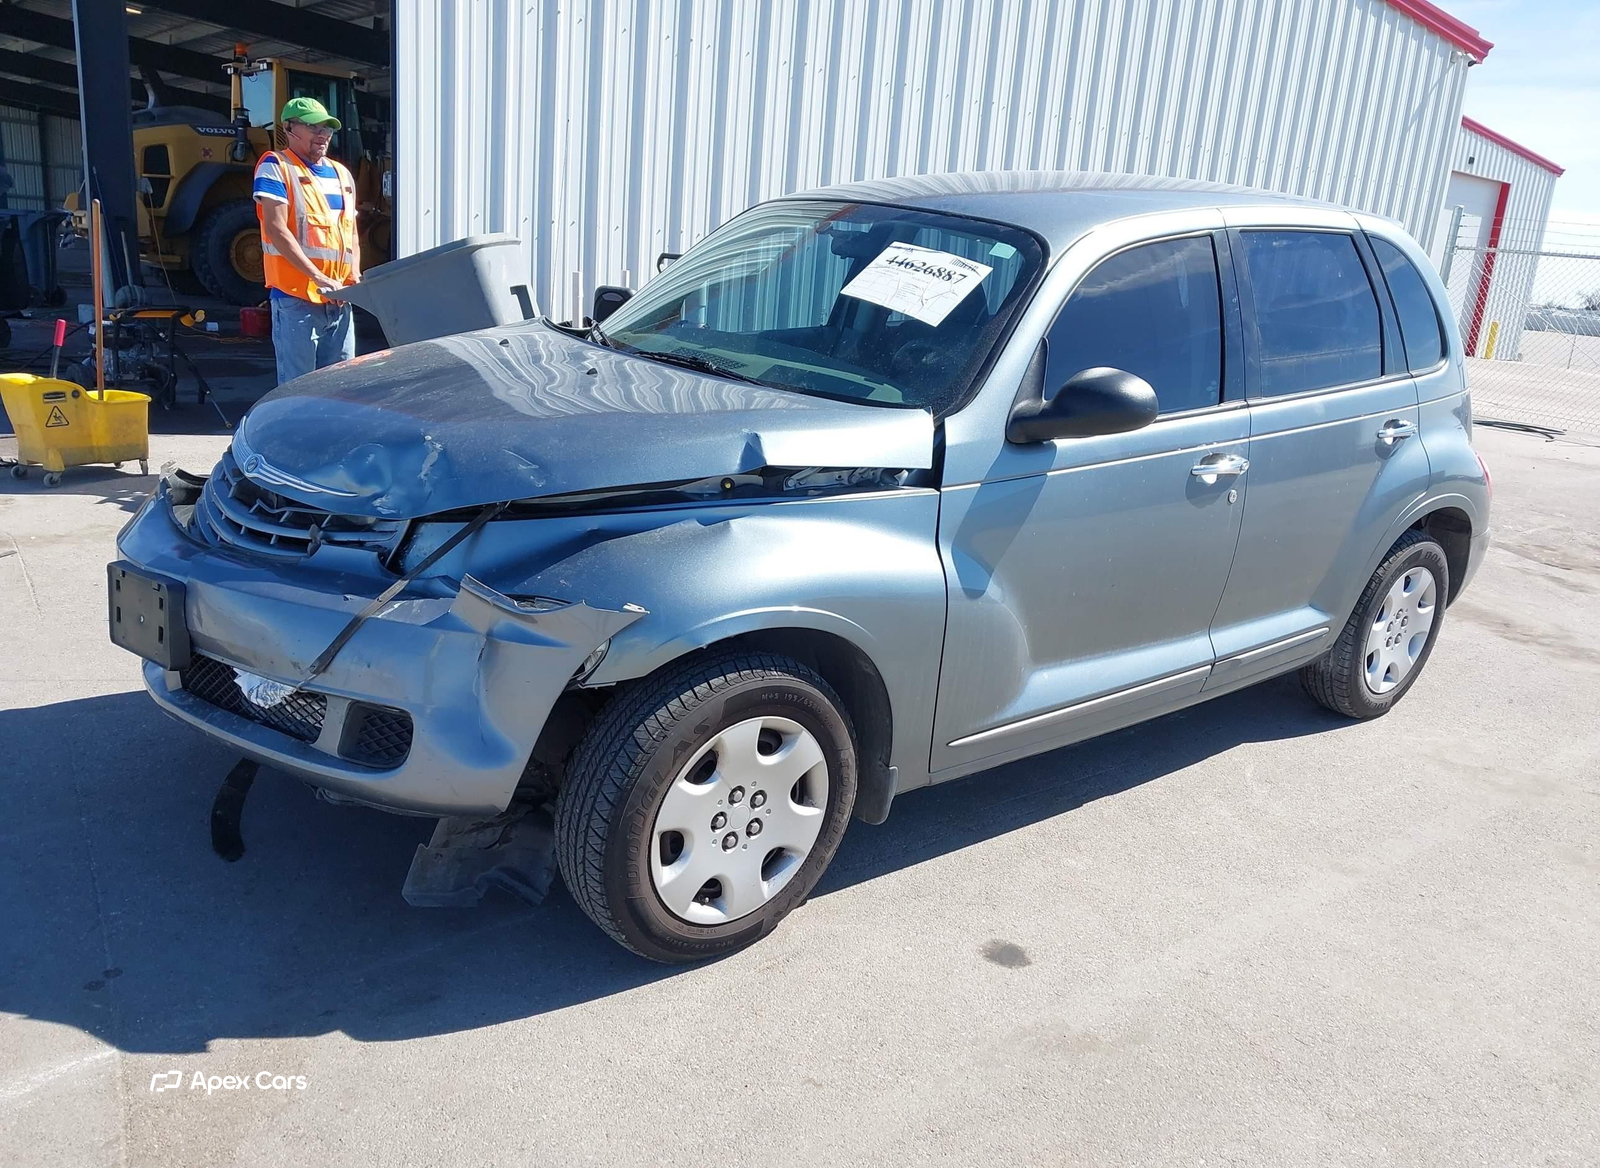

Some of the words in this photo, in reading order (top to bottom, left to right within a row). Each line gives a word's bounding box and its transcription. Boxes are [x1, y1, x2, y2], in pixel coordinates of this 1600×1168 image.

[196, 127, 236, 135] VOLVO
[885, 254, 968, 285] 44626887
[626, 715, 711, 881] DOUGLAS
